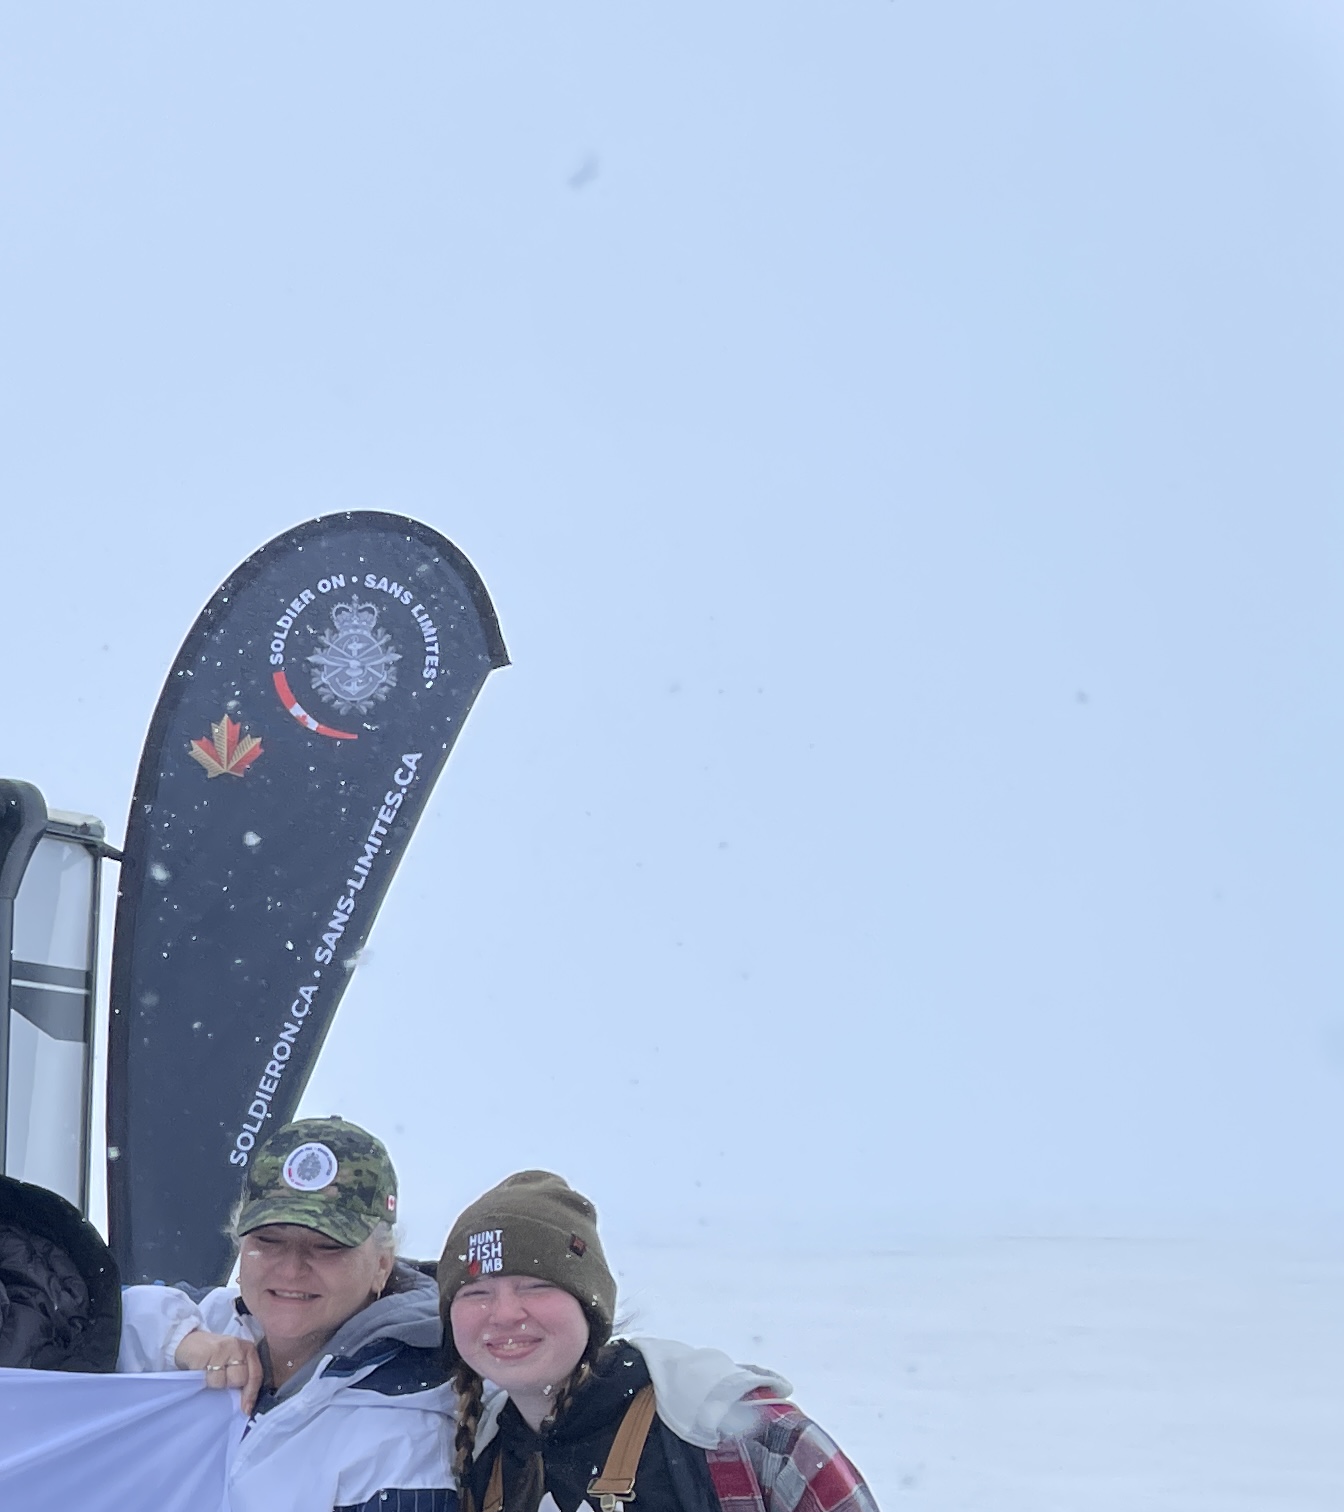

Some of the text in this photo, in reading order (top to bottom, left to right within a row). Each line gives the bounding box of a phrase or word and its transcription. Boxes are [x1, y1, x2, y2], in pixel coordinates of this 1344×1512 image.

[269, 573, 440, 680] SOLDIER ON SANS LIMITES
[229, 985, 319, 1167] SOLDIERON.CA
[314, 752, 422, 965] SANS-LIMITES.CA
[469, 1229, 504, 1246] HUNT
[468, 1242, 503, 1264] FISH
[481, 1258, 503, 1275] MB
